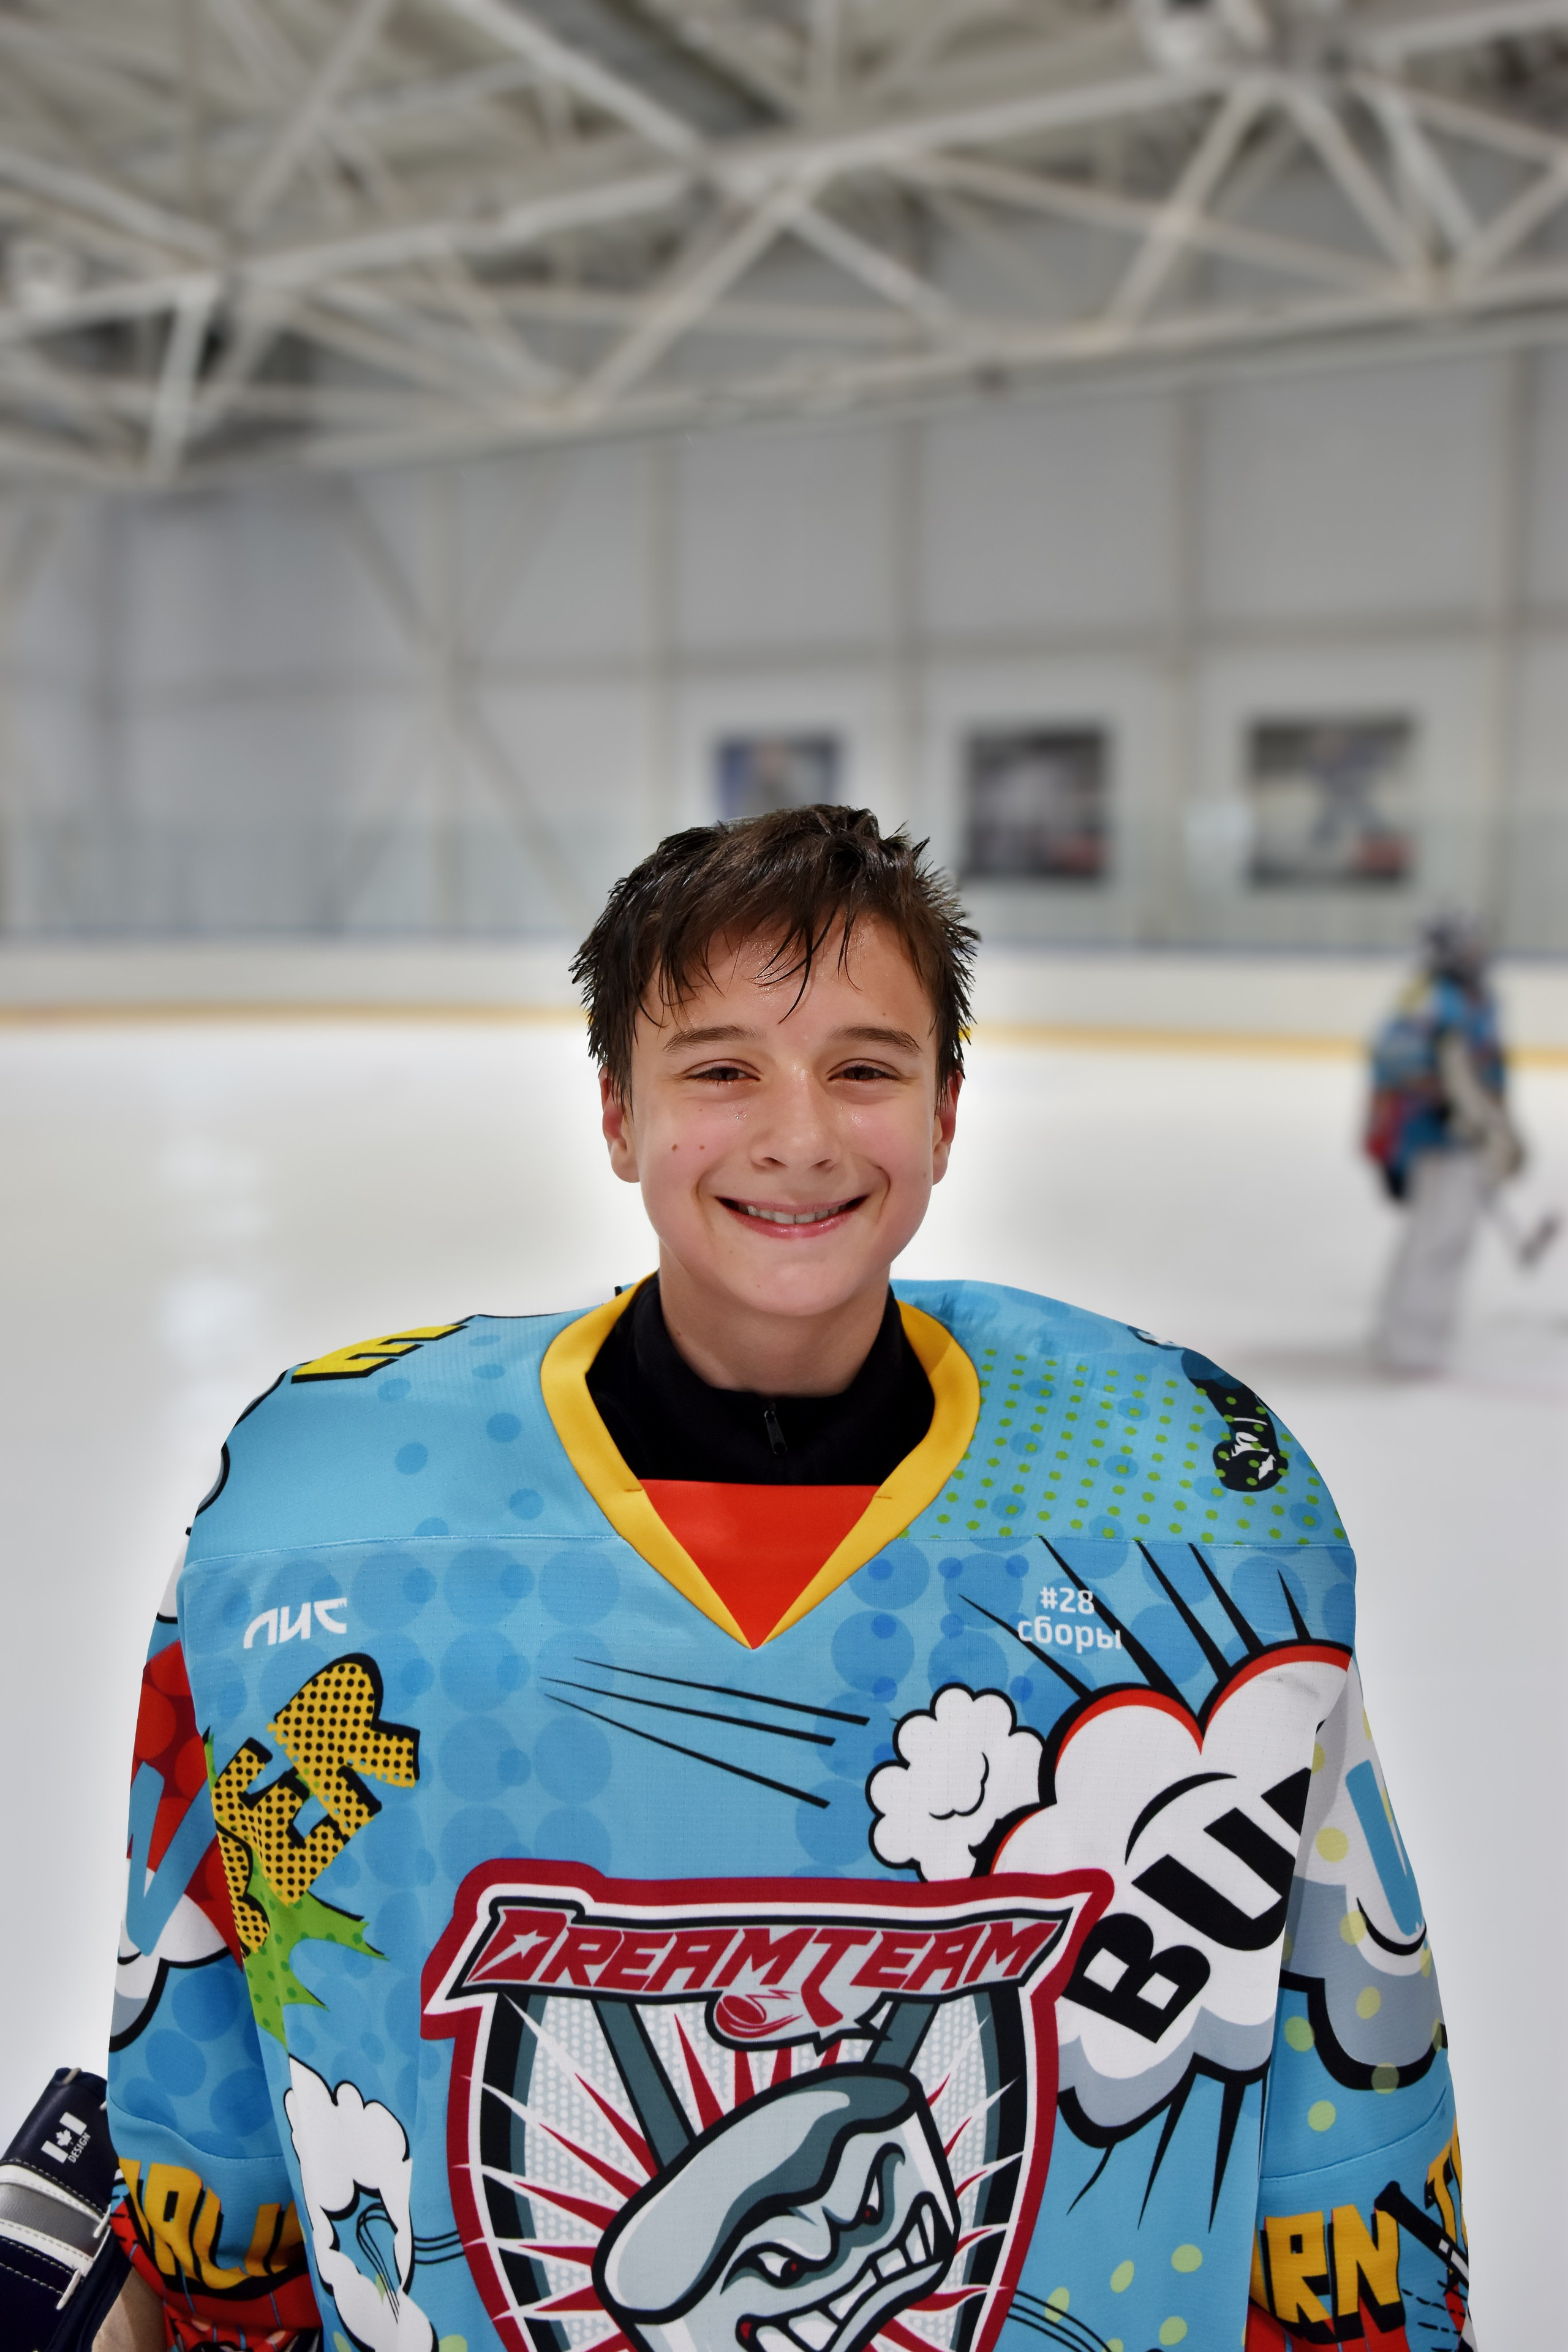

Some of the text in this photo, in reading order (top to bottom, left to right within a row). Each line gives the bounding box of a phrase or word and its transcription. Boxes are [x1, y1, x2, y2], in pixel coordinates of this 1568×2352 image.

[1039, 1586, 1095, 1615] #28
[1017, 1615, 1122, 1654] сборы
[67, 2132, 91, 2163] DESIGN
